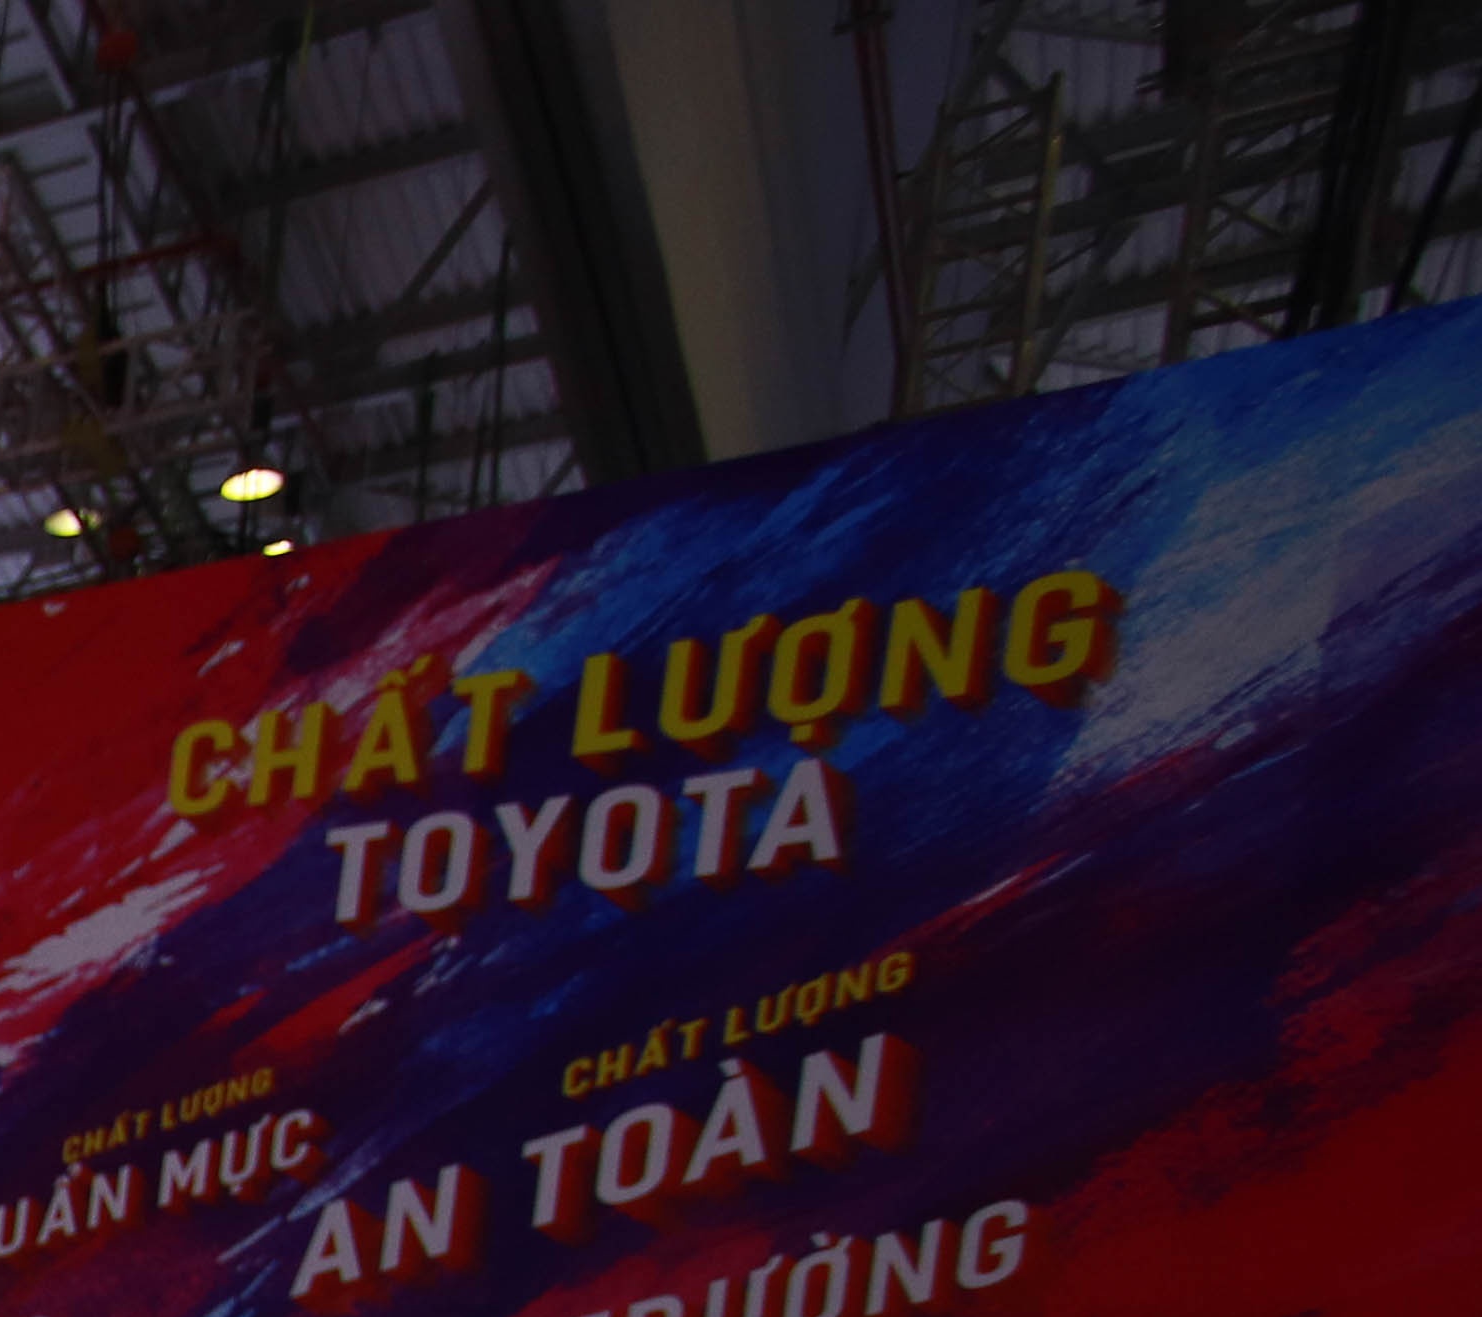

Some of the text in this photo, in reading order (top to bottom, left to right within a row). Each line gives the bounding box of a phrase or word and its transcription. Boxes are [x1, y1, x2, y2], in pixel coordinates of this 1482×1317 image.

[167, 571, 1105, 819] CHẤT LƯỢNG
[325, 758, 843, 923] TOYOTA
[158, 1109, 315, 1209] MỰC
[288, 1032, 887, 1299] AN TOÀN
